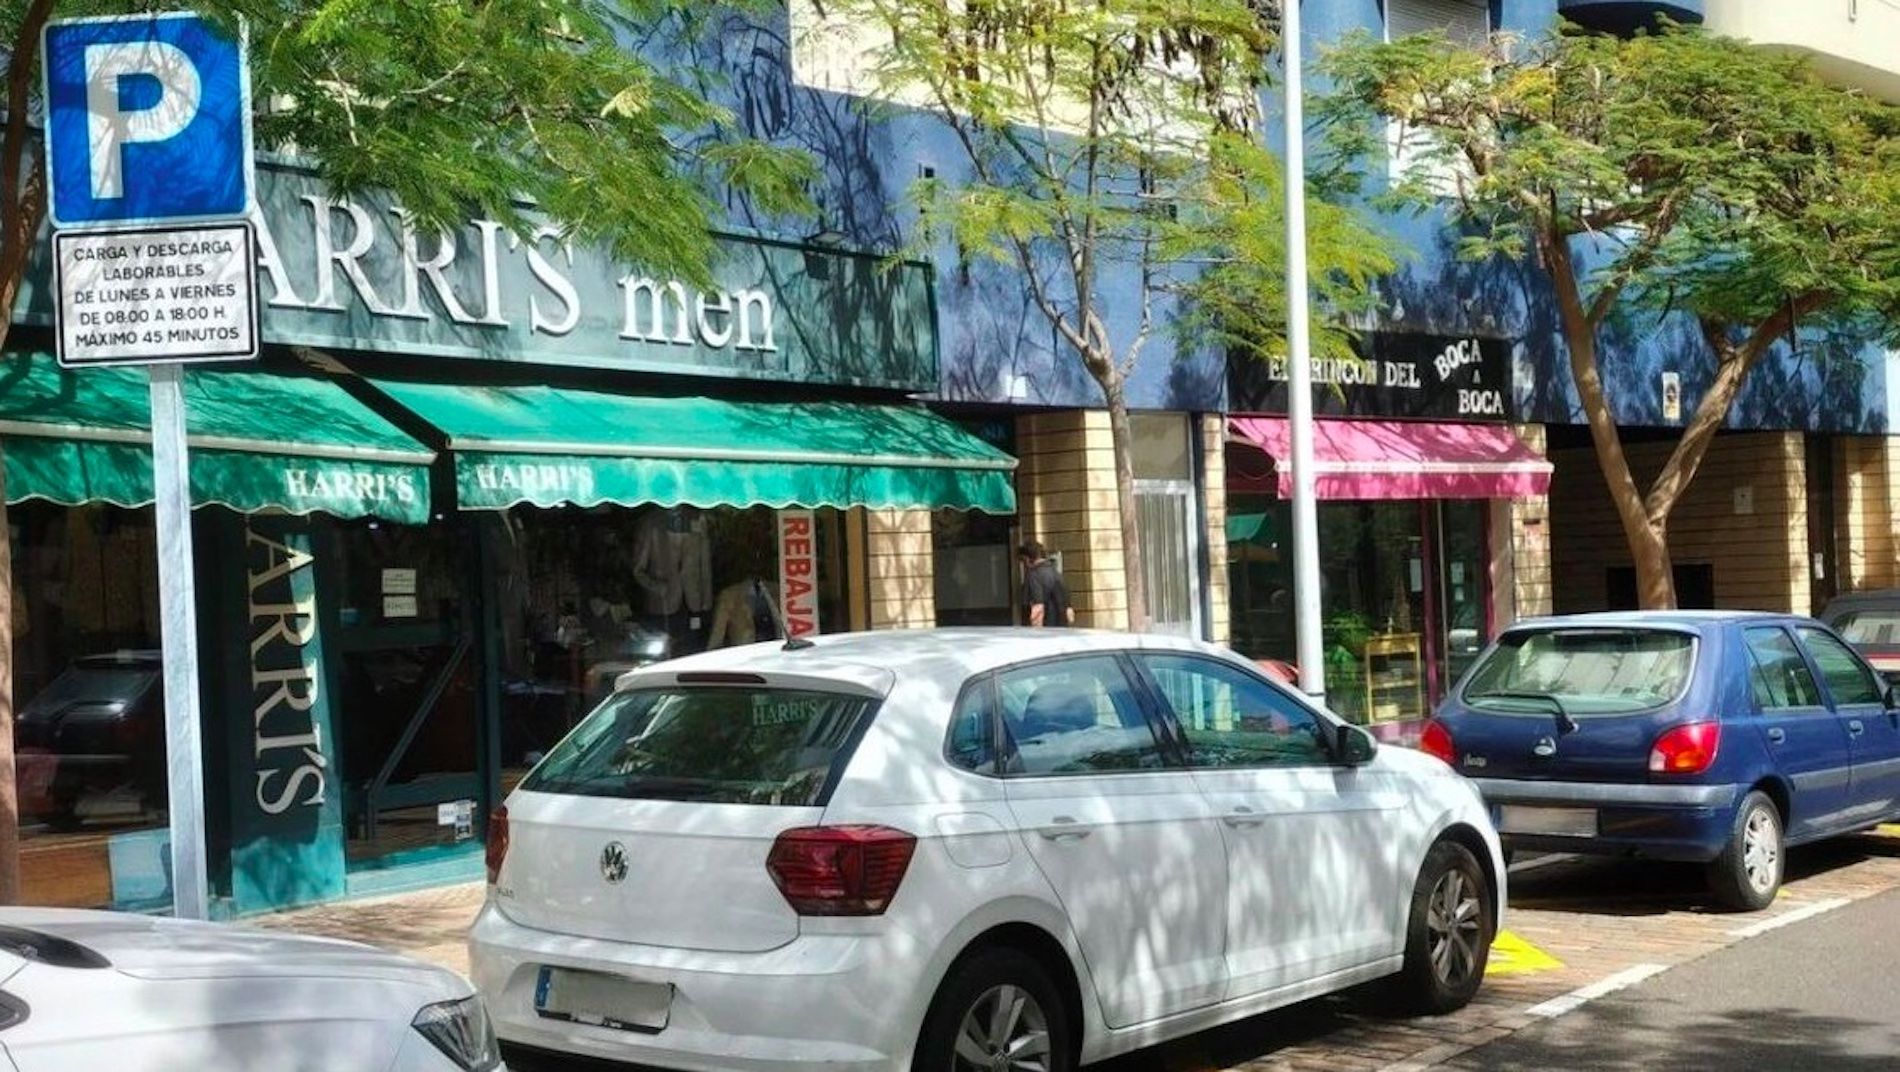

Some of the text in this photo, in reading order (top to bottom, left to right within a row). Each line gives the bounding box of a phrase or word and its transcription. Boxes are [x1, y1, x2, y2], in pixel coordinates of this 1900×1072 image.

[84, 41, 201, 199] P
[73, 241, 233, 261] CARGA Y DESCARGA
[103, 264, 205, 281] LABORABLES
[249, 195, 779, 353] ARRI'S men
[75, 284, 236, 304] DE LUNES A VIERNES
[80, 312, 100, 325] DE
[155, 309, 165, 321] A
[143, 331, 163, 343] 45
[168, 327, 239, 343] MINUTOS
[1433, 338, 1482, 382] BOCA
[1384, 361, 1422, 388] DEL
[1472, 369, 1481, 384] A
[1458, 389, 1504, 414] BOCA
[286, 469, 415, 502] HARRI'S
[476, 463, 594, 499] HARRI'S
[783, 517, 815, 636] REBAJA
[246, 513, 327, 815] ARRI'S
